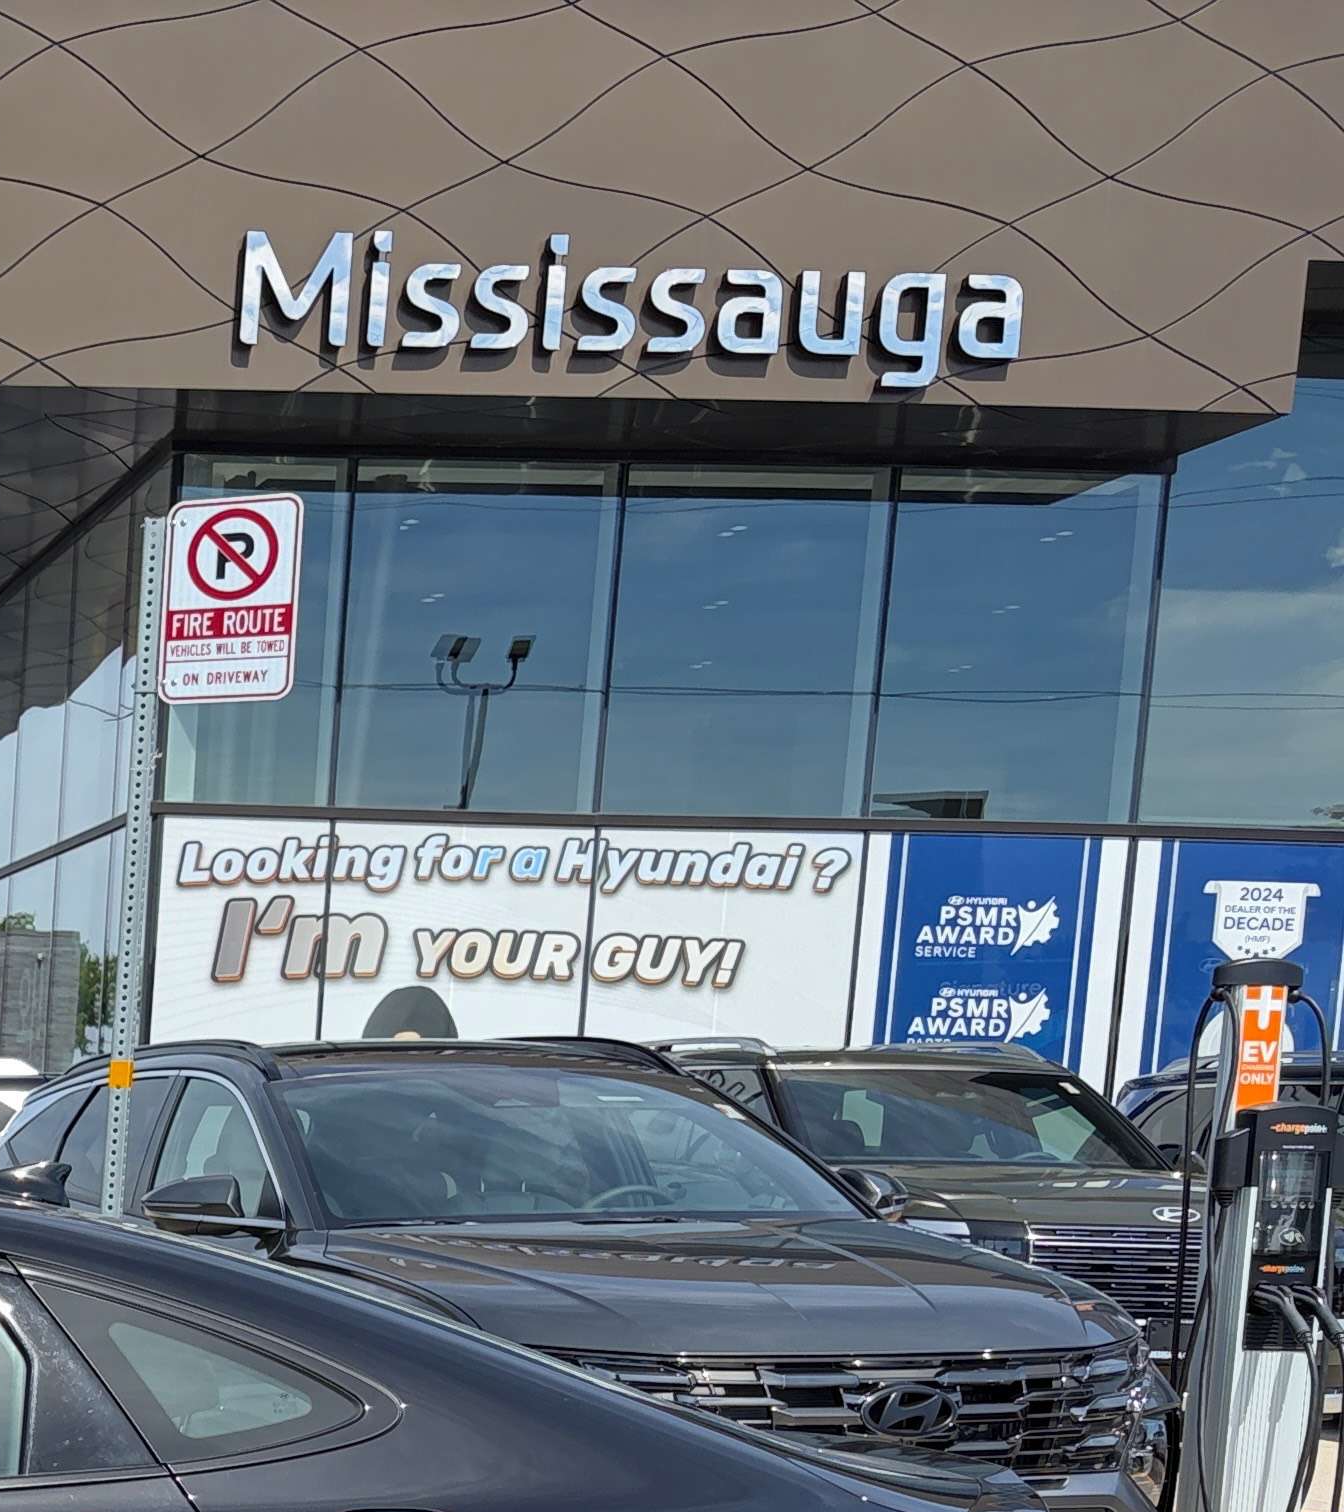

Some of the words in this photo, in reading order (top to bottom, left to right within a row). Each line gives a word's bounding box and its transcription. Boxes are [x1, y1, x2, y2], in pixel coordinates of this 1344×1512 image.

[238, 229, 1025, 389] Mississauga
[171, 611, 214, 638] FIRE
[222, 607, 286, 634] ROUTE
[169, 643, 212, 657] VEHICLES
[216, 642, 236, 655] WILL
[240, 641, 252, 654] BE
[256, 639, 285, 653] TOWED
[182, 673, 199, 686] ON
[206, 669, 268, 685] DRIVEWAY
[176, 834, 407, 893] Looking
[413, 833, 507, 882] for
[511, 846, 551, 883] a
[555, 838, 806, 895] Hyundai
[1239, 886, 1284, 903] 2024
[939, 905, 1019, 927] PSMR
[1224, 904, 1262, 914] DEALER
[1263, 905, 1277, 914] OF
[1278, 906, 1297, 915] THE
[1223, 916, 1296, 932] DECADE
[210, 895, 390, 983] I'm
[413, 928, 582, 981] YOUR
[590, 932, 746, 990] GUY!
[915, 925, 1015, 945] AWARD
[1244, 935, 1271, 944] (HMF)
[914, 945, 977, 958] SERVICE
[930, 997, 1009, 1018] PSMR
[906, 1016, 1006, 1037] AWARD
[1242, 1040, 1278, 1063] EV
[1240, 1072, 1275, 1085] ONLY
